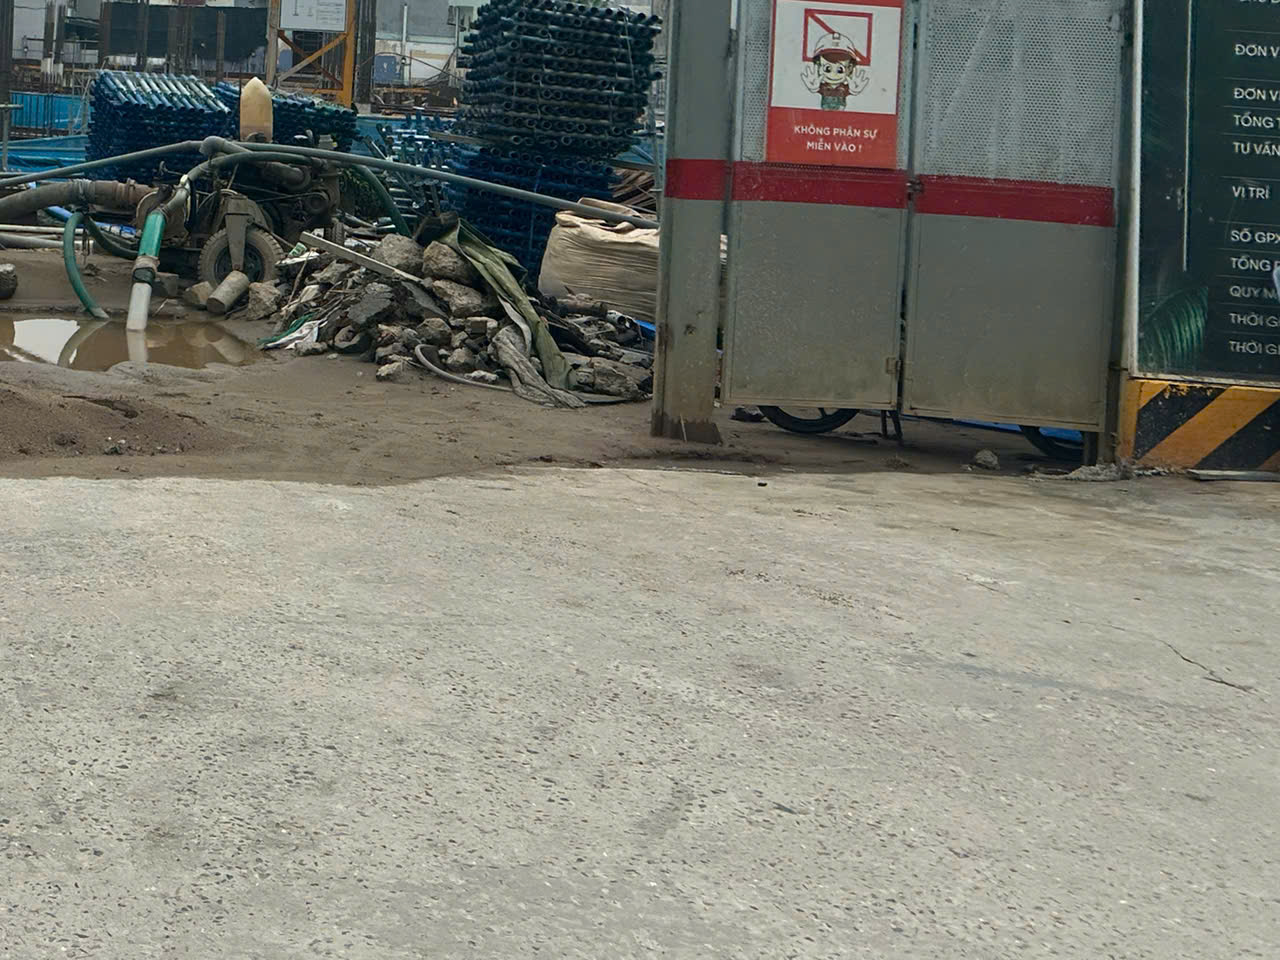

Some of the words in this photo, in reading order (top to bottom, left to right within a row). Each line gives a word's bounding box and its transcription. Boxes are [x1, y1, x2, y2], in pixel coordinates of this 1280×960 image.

[1234, 44, 1267, 57] ĐƠN
[1233, 87, 1266, 101] ĐƠN
[794, 123, 830, 136] KHÔNG
[863, 129, 878, 141] SỰ
[833, 141, 856, 152] VÀO
[1233, 141, 1251, 154] TƯ
[1232, 186, 1245, 198] VỊ
[1248, 185, 1270, 200] TRÍ
[1231, 228, 1251, 242] SỐ
[1229, 285, 1261, 298] QUY
[1228, 312, 1264, 326] THỜI
[1228, 340, 1262, 354] THỜI
